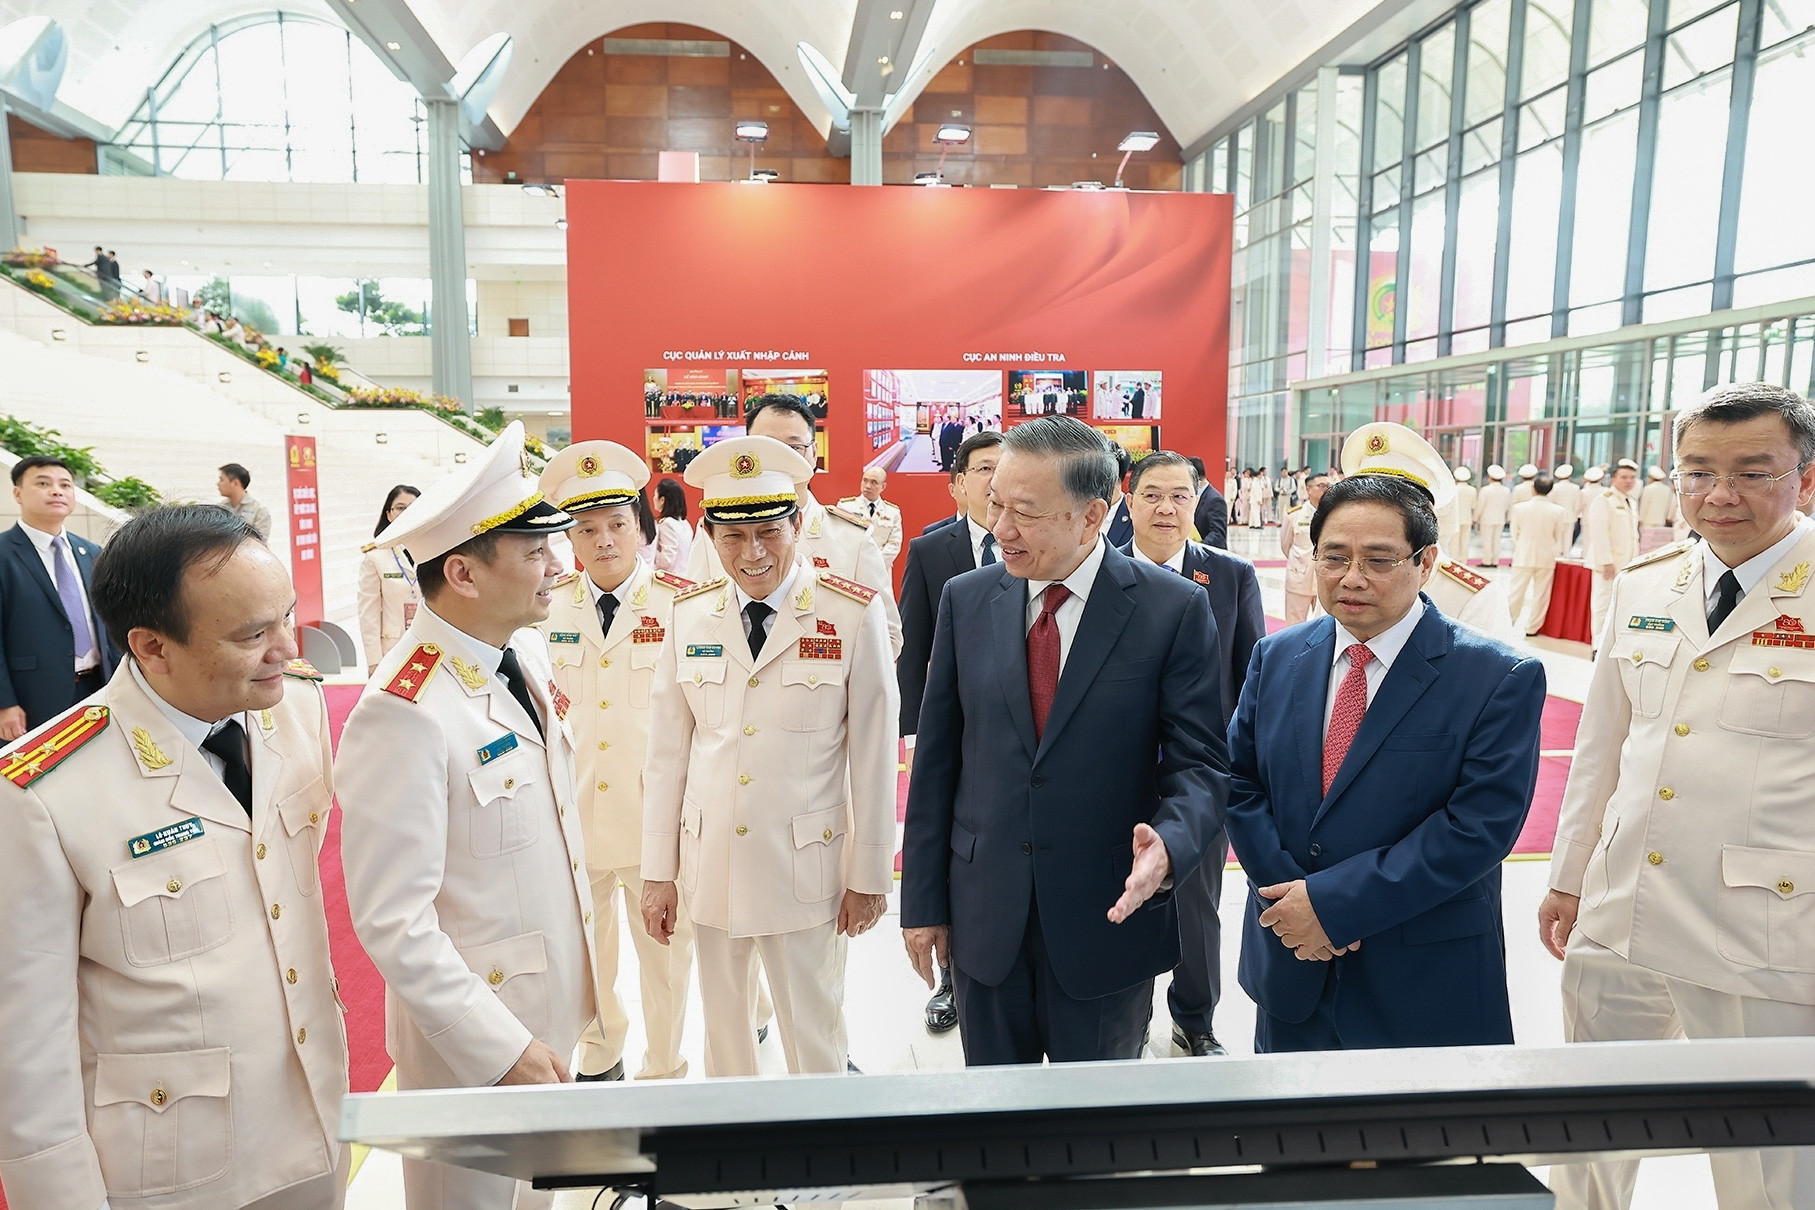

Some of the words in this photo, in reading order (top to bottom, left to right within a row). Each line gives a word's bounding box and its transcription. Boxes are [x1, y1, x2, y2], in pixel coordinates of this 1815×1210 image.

[663, 351, 683, 362] CỤC
[684, 349, 712, 361] QUẢN
[713, 349, 725, 361] LÝ
[726, 349, 752, 361] XUẤT
[753, 350, 781, 362] NHẬP
[781, 349, 810, 361] CẢNH
[963, 352, 983, 363] CỤC
[984, 353, 997, 362] AN
[999, 353, 1022, 362] NINH
[1024, 351, 1045, 362] ĐIỀU
[1047, 353, 1067, 362] TRA
